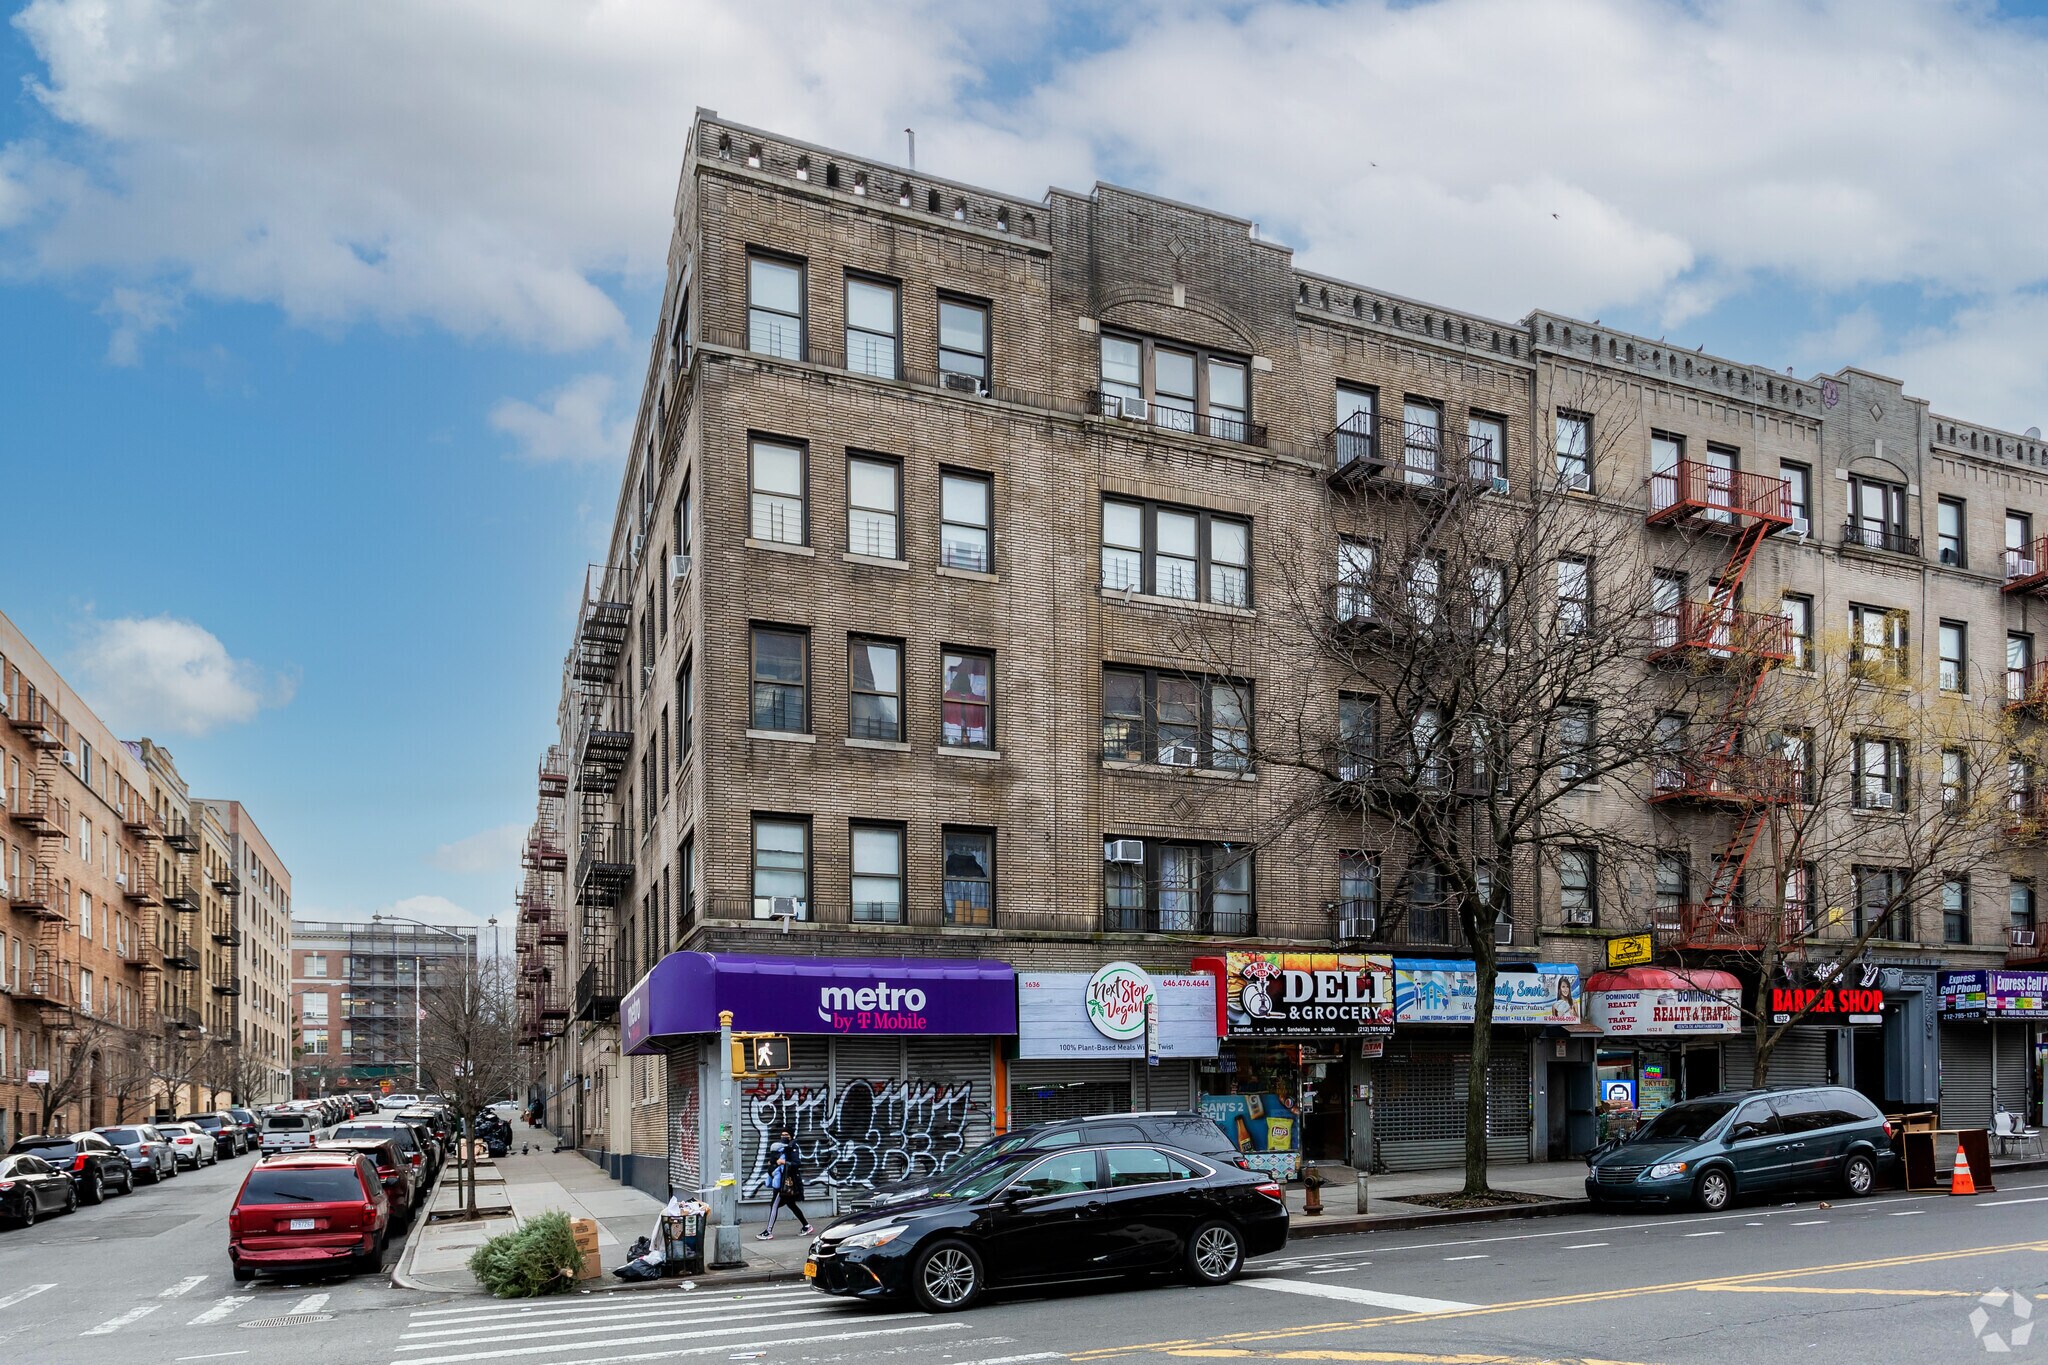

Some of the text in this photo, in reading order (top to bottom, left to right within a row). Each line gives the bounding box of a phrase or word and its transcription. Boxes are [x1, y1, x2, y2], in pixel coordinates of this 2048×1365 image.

[1245, 962, 1274, 977] SAM'S
[1163, 979, 1210, 987] 646.476.4644
[1282, 970, 1387, 1003] DELI
[1949, 974, 1976, 985] Express
[1997, 975, 2026, 992] Express
[2027, 975, 2041, 991] Cell
[1092, 976, 1149, 1003] Next Stop
[1940, 983, 1982, 995] Cell Phone
[818, 982, 927, 1022] metro
[1462, 1002, 1472, 1010] We
[1502, 1002, 1508, 1011] of
[1510, 1004, 1524, 1012] your
[1525, 1003, 1546, 1011] Future
[1608, 1001, 1637, 1009] REALTY
[1839, 989, 1883, 1013] SHOP
[1103, 997, 1143, 1025] Vegan
[1653, 1006, 1732, 1022] REALTY & TRAVEL
[833, 1012, 854, 1033] by
[873, 1012, 927, 1029] Mobile
[1118, 1043, 1136, 1051] Meals
[1202, 1102, 1244, 1112] SAM'S 2
[1202, 1112, 1226, 1122] DELI
